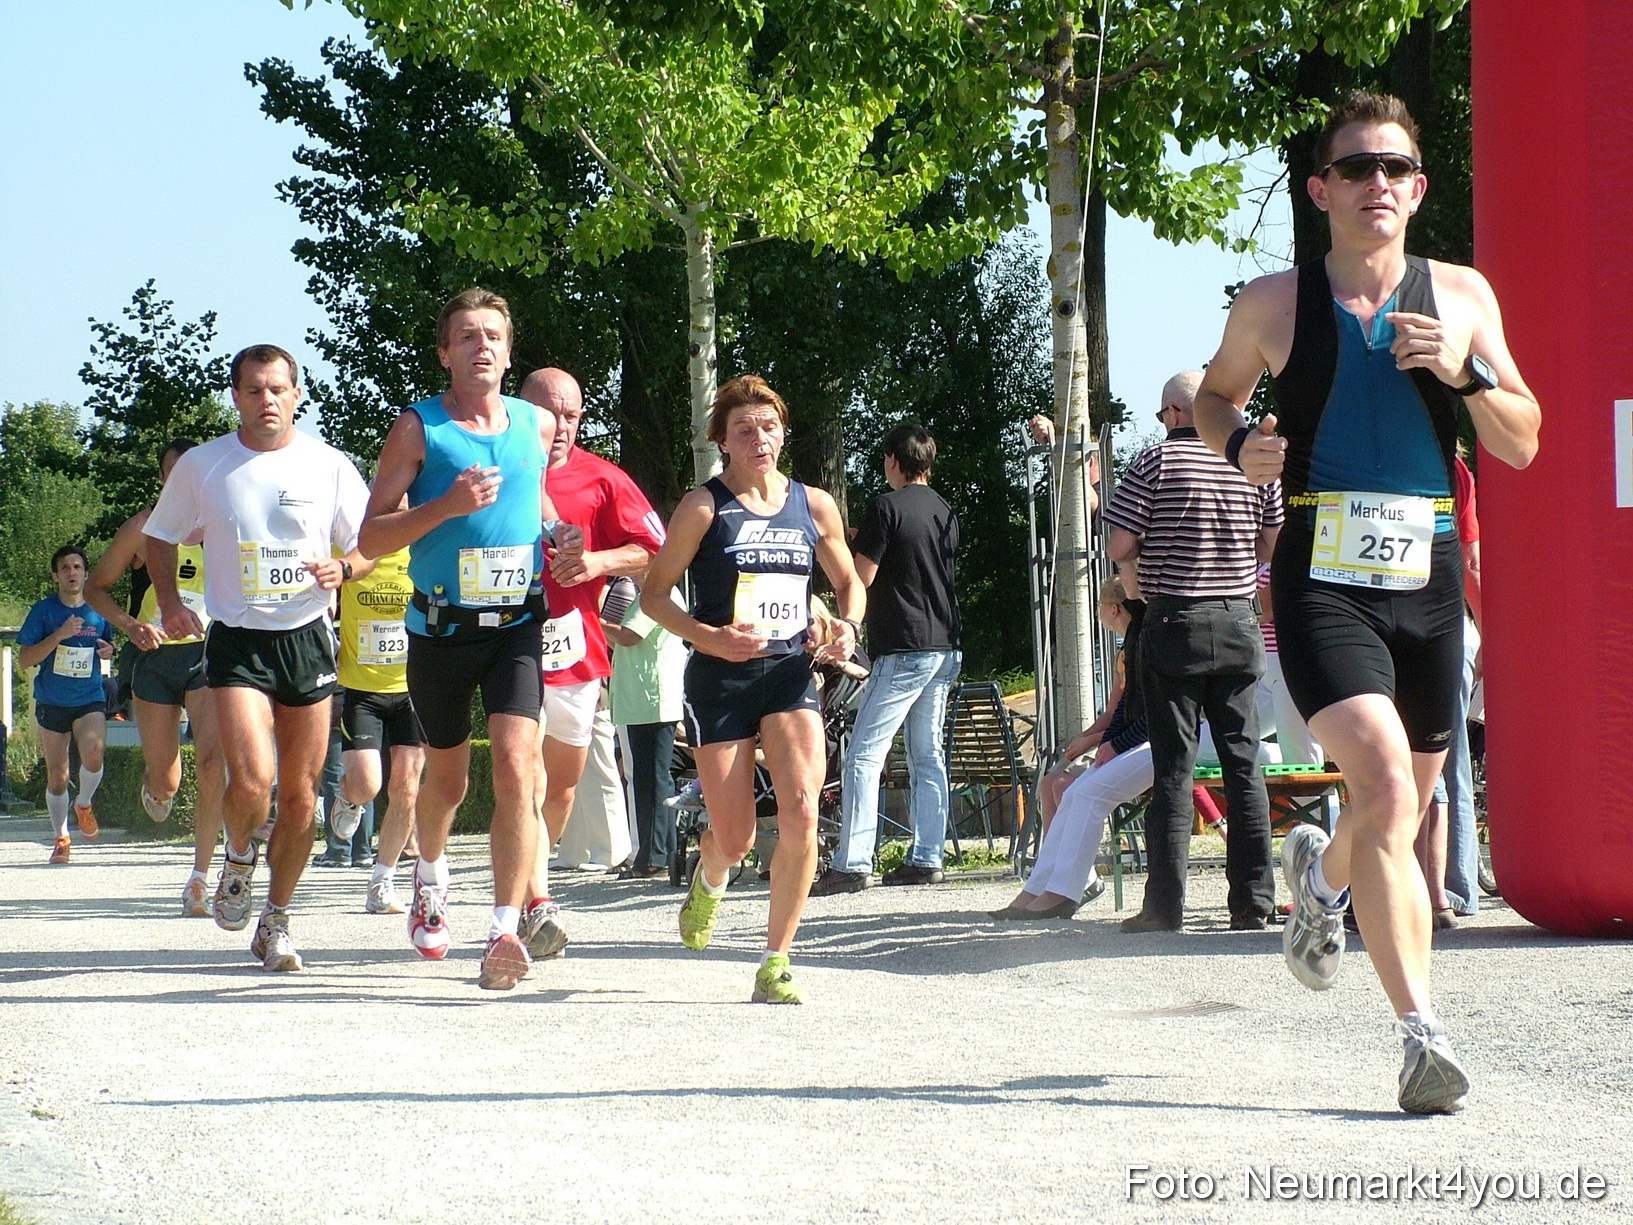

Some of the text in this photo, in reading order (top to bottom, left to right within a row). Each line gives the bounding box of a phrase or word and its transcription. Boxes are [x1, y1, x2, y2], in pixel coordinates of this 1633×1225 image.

[1350, 501, 1405, 521] Markus
[1320, 525, 1329, 537] A
[260, 547, 299, 558] Thomas
[482, 547, 516, 559] Harald
[1358, 534, 1414, 562] 257
[735, 550, 809, 566] SC Roth 52
[243, 565, 249, 575] A
[270, 567, 305, 585] 806
[463, 566, 469, 576] A
[1312, 566, 1357, 580] BOCK
[491, 568, 527, 587] 773
[1384, 574, 1428, 585] PFLEIDERER
[758, 602, 799, 620] 1051
[372, 624, 400, 634] Werner
[378, 639, 405, 653] 823
[541, 635, 571, 655] 221
[70, 660, 88, 670] 136
